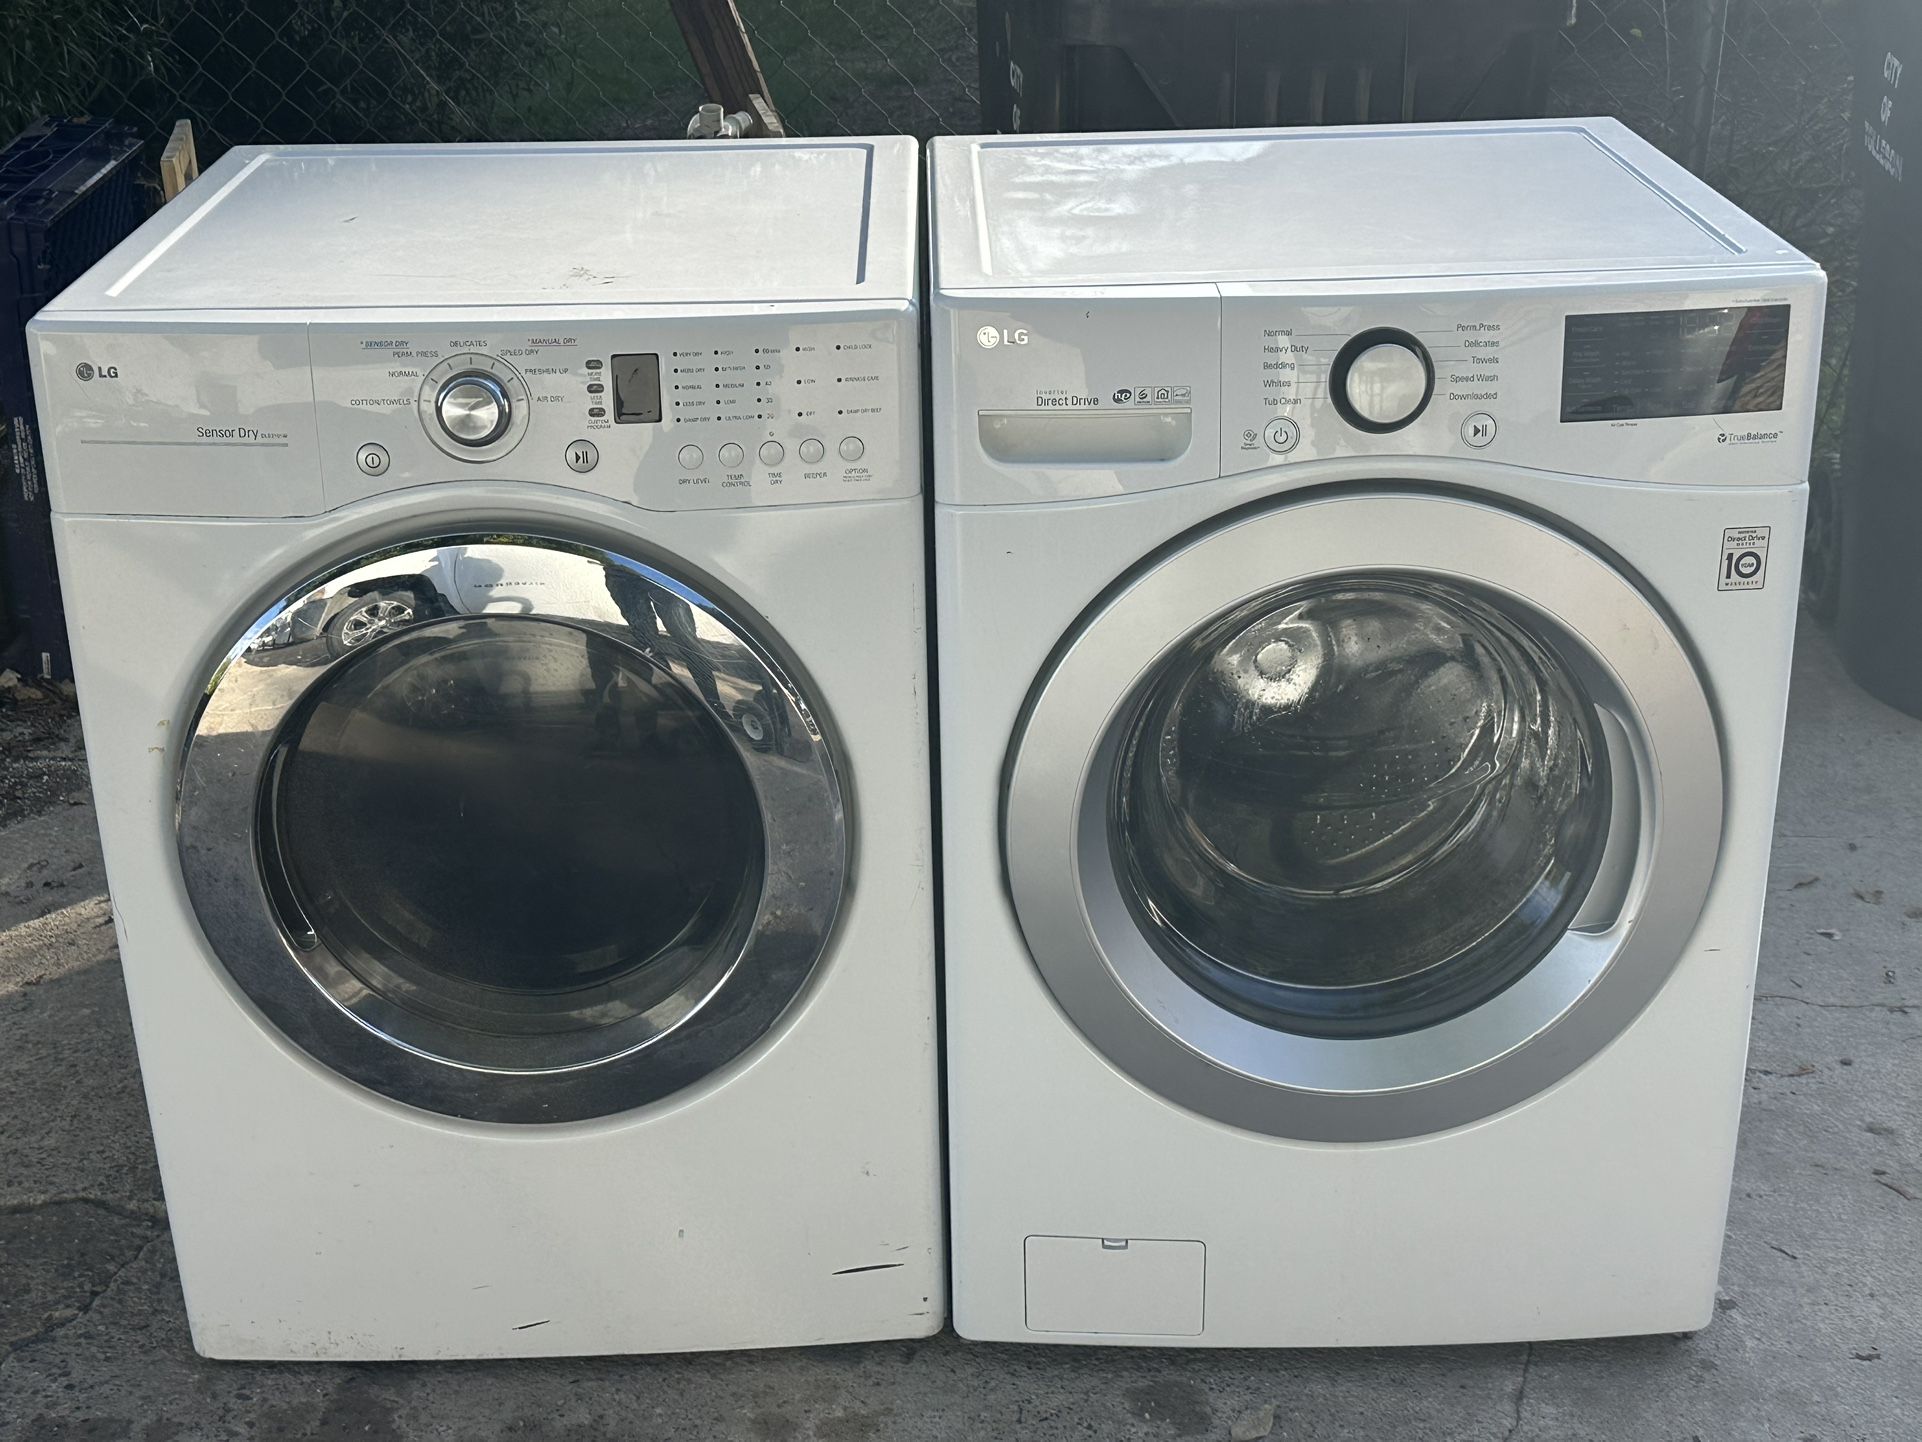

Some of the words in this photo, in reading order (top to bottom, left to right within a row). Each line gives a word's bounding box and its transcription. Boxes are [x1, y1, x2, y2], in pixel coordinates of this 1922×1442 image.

[1884, 52, 1902, 88] CITY
[1881, 96, 1892, 126] OF
[1003, 329, 1029, 345] LG
[1263, 329, 1293, 337] Normal
[1464, 339, 1500, 348] Delicates
[501, 349, 523, 357] SPEED
[1263, 345, 1289, 354] Heavy
[1290, 345, 1309, 354] Duty
[1471, 356, 1499, 365] Towels
[1263, 361, 1296, 371] Bedding
[98, 366, 119, 379] LG
[1263, 379, 1292, 388] Whites
[1450, 374, 1475, 384] Speed
[1476, 373, 1499, 382] Wash
[1449, 391, 1498, 401] Downloaded
[350, 398, 411, 406] COTTON/TOWELS
[1036, 396, 1069, 407] Direct
[1071, 396, 1099, 406] Drive
[1264, 398, 1278, 406] Tub
[1280, 397, 1302, 405] Clean
[196, 426, 235, 439] Sensor
[238, 427, 259, 440] Dry
[1728, 432, 1779, 442] TrueBalance
[1727, 535, 1747, 543] Direct
[1748, 534, 1766, 542] Drive
[1725, 551, 1762, 580] 10
